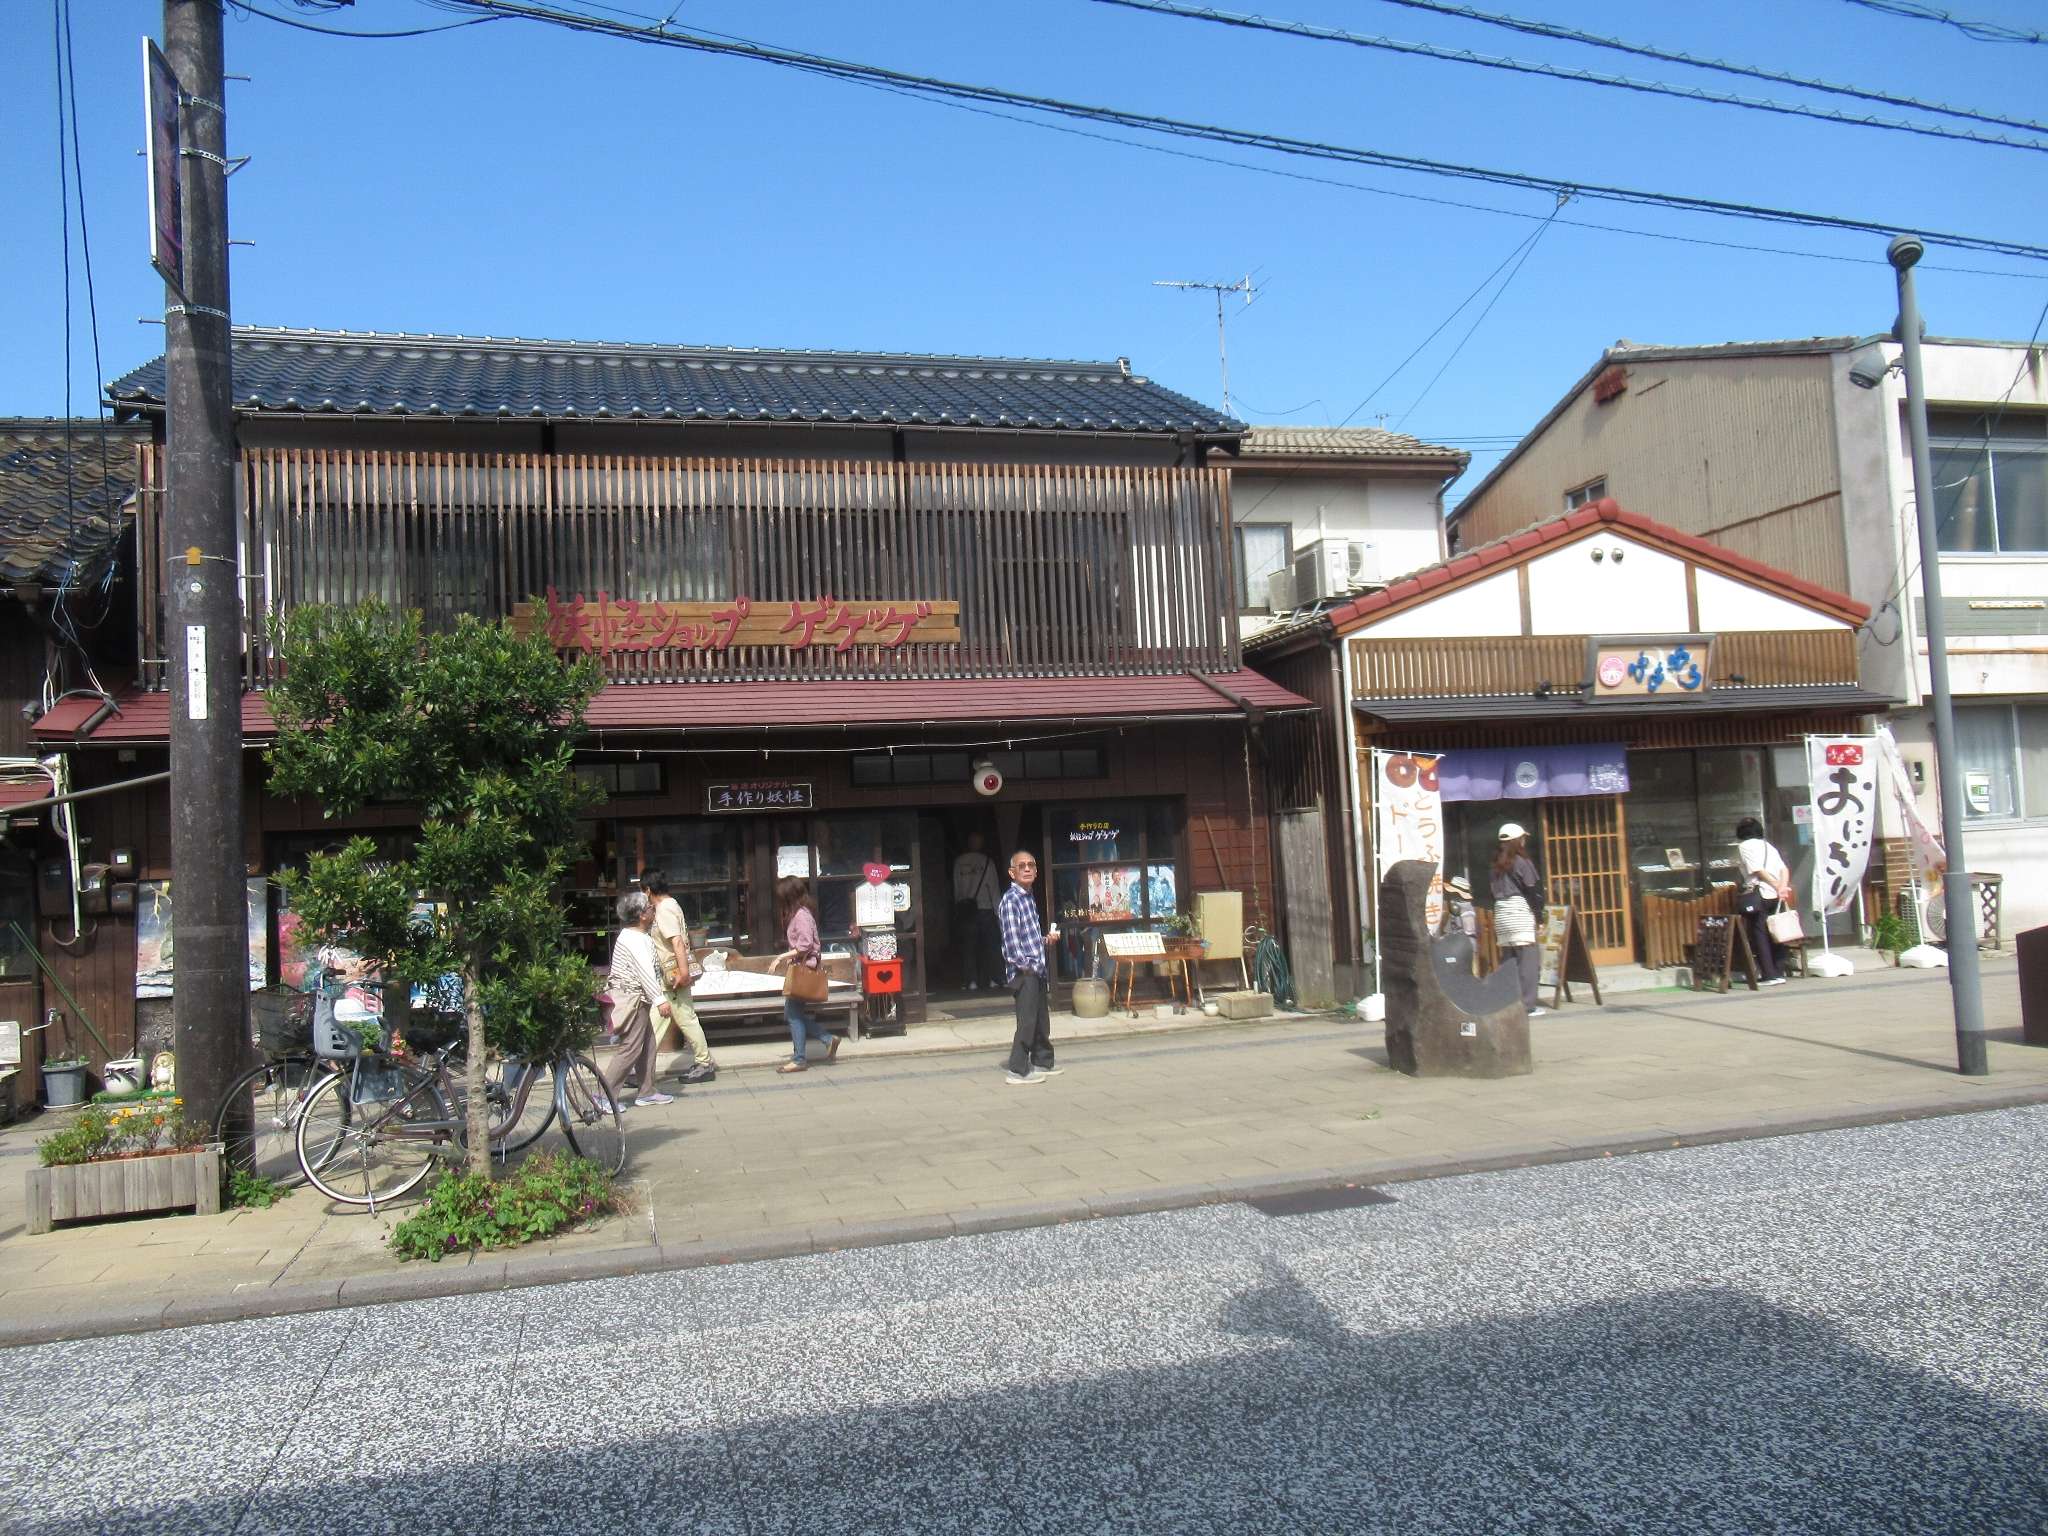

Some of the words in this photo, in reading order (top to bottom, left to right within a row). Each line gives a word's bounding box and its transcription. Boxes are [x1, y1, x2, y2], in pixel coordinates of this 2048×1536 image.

[547, 585, 749, 656] 妖怪ショップ
[779, 593, 933, 652] ゲゲゲ
[717, 789, 804, 807] 手作り妖怪
[1391, 802, 1409, 854] ドー
[1817, 767, 1873, 900] おにぎり
